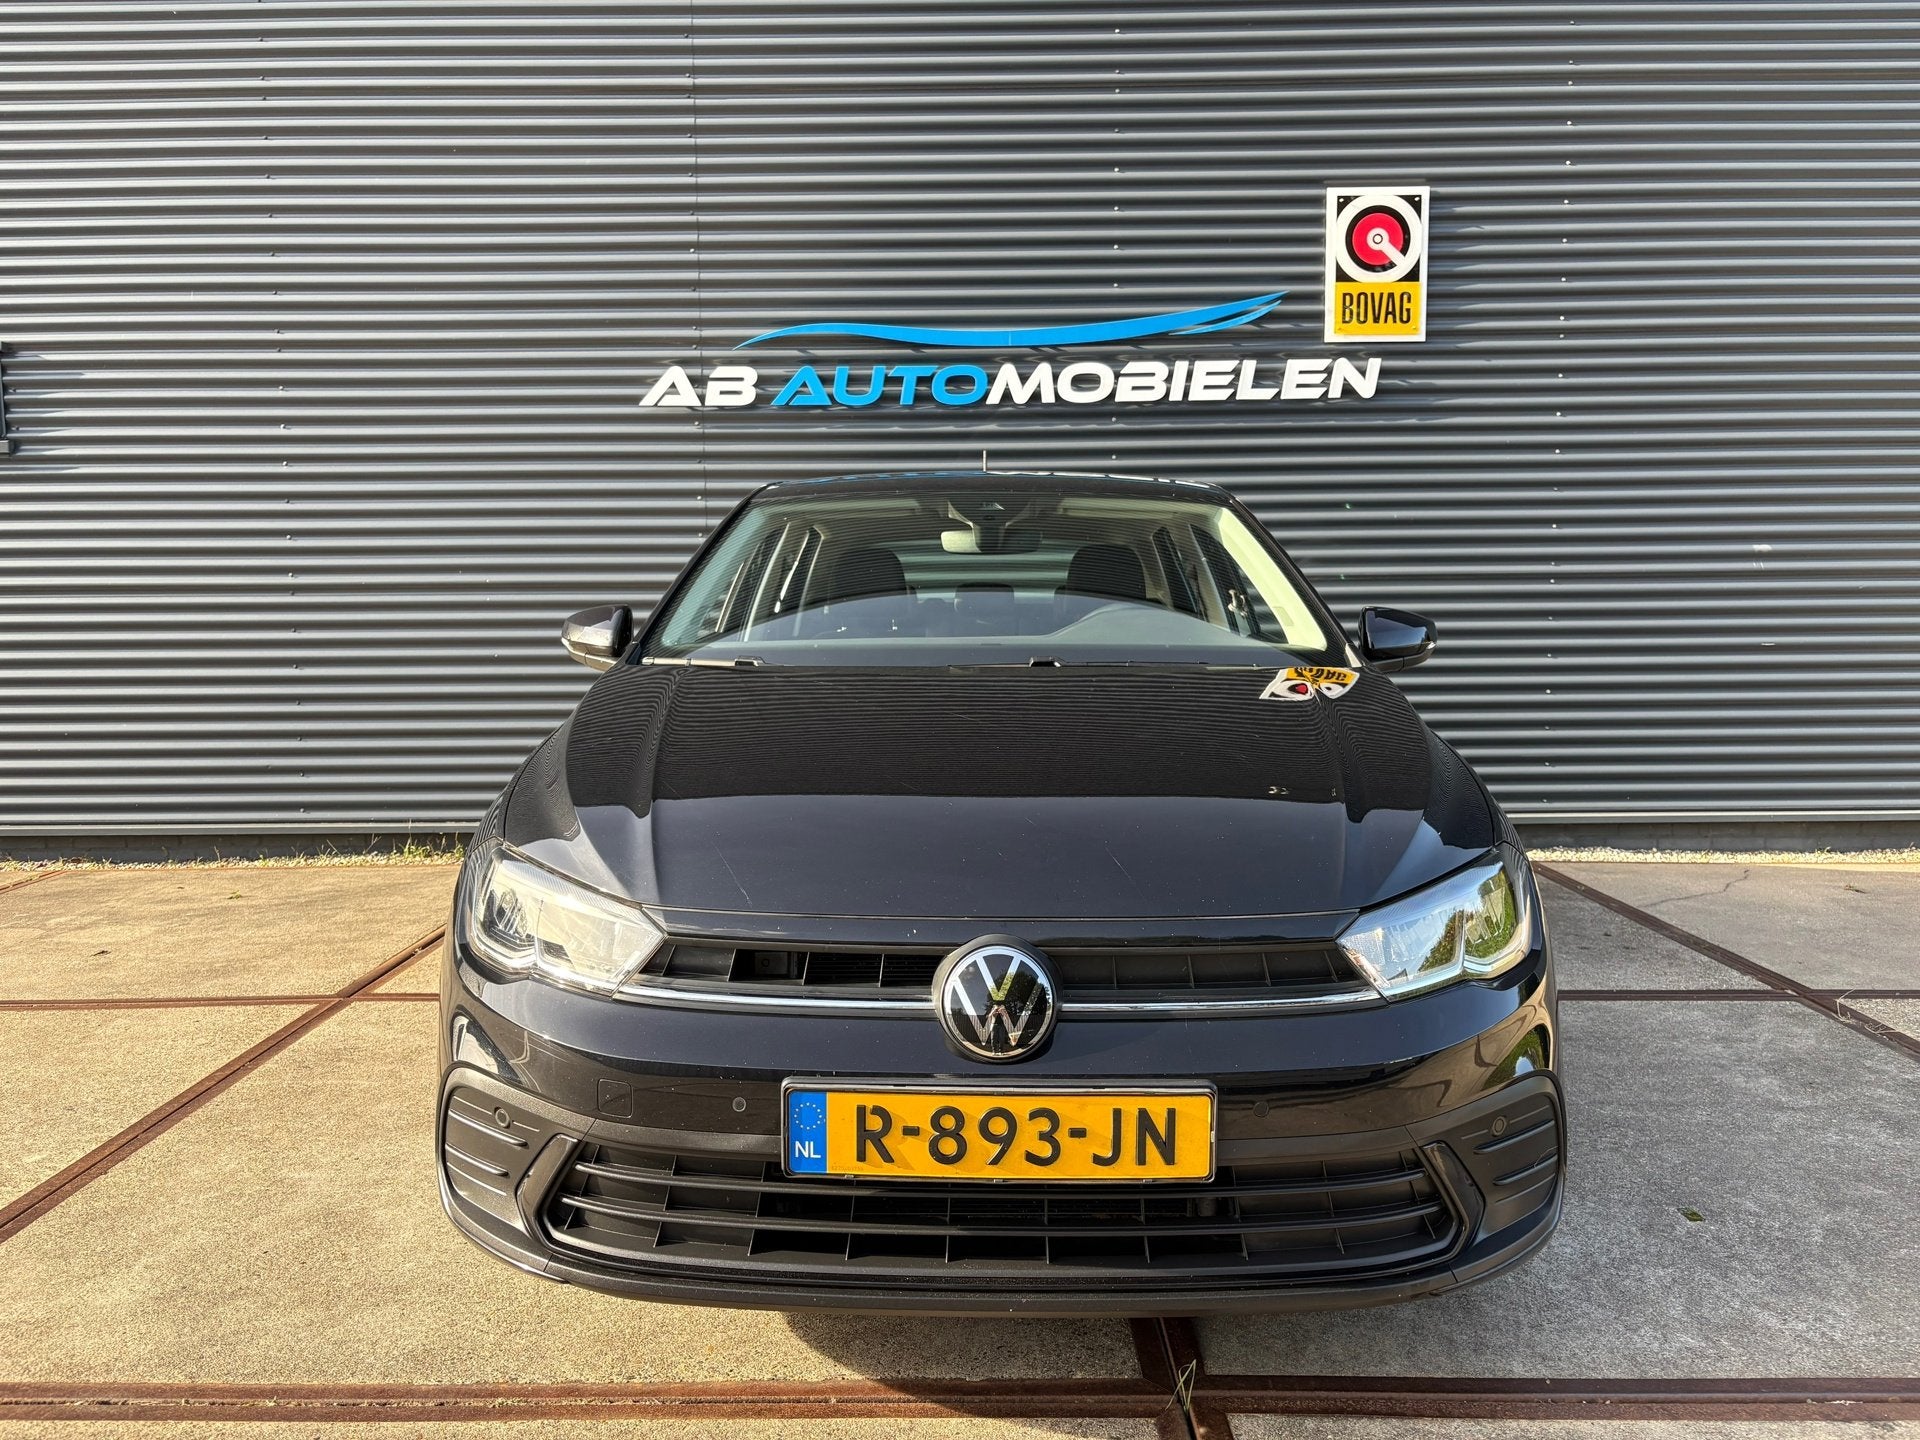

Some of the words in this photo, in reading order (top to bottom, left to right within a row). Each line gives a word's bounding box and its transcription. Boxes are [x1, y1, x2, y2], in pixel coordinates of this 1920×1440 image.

[1342, 291, 1412, 325] BOVAG
[638, 365, 759, 407] AB
[770, 356, 1382, 407] AUTOMOBIELEN
[794, 1139, 822, 1160] NL
[855, 1103, 1177, 1167] R-893-JN
